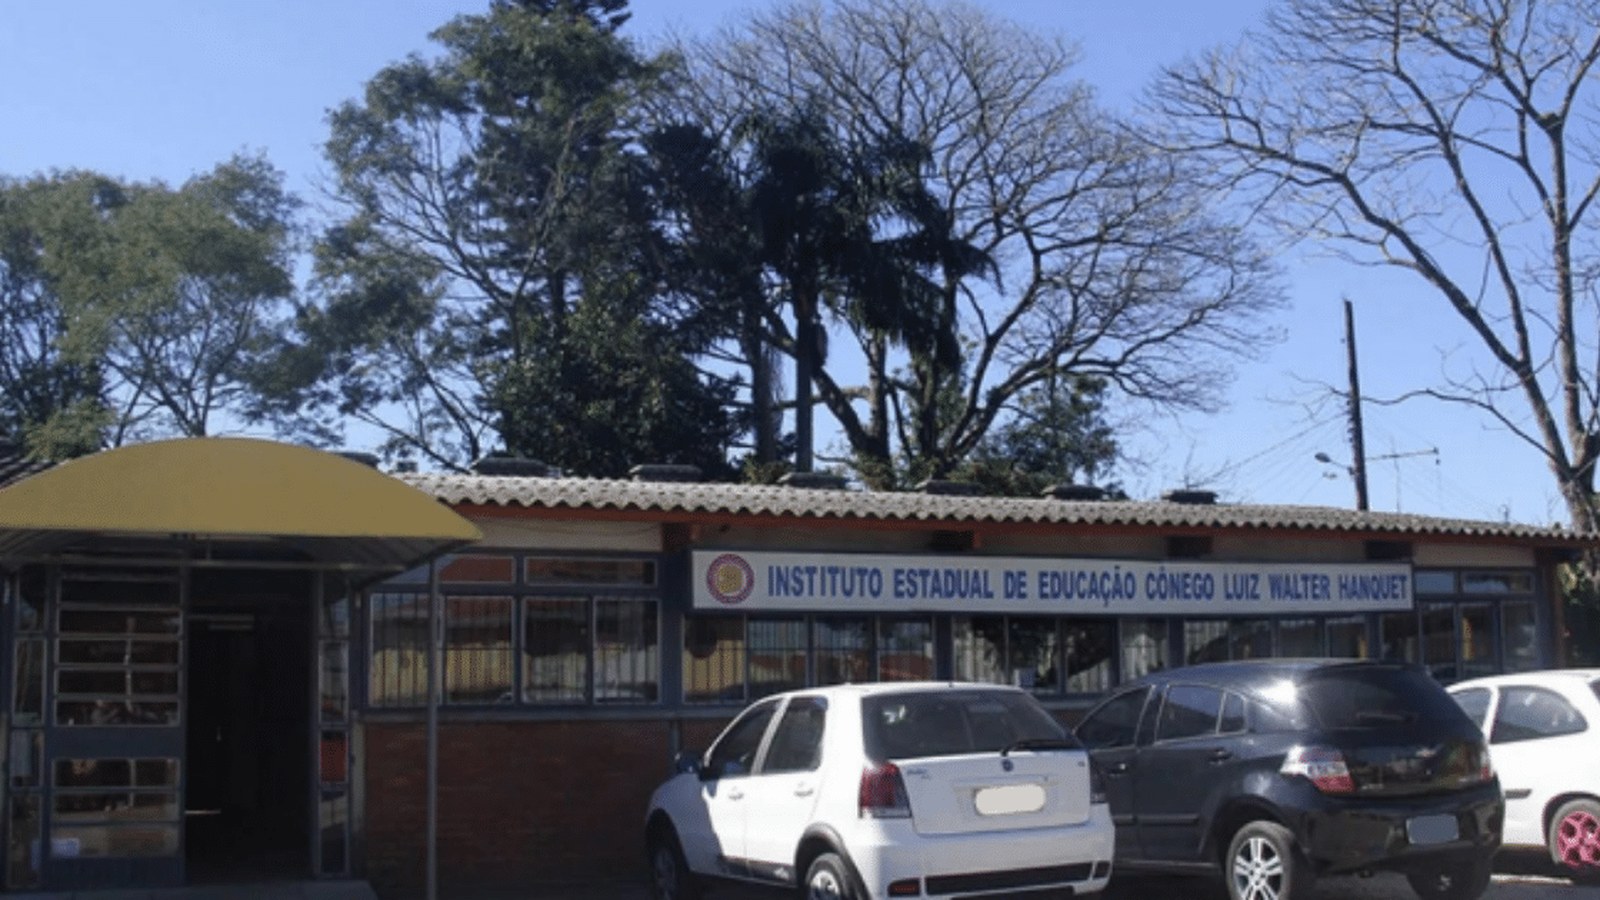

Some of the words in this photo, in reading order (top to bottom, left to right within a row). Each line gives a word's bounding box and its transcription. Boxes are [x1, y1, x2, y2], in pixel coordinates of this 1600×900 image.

[768, 565, 883, 598] INSTITUTO
[894, 568, 994, 599] ESTADUAL
[1004, 571, 1027, 599] DE
[1038, 565, 1136, 607] EDUCAÇÃO
[1145, 566, 1213, 601] CÔNEGO
[1224, 573, 1260, 601] LUIZ
[1269, 573, 1331, 601] WALTER
[1339, 574, 1407, 601] HANQUET
